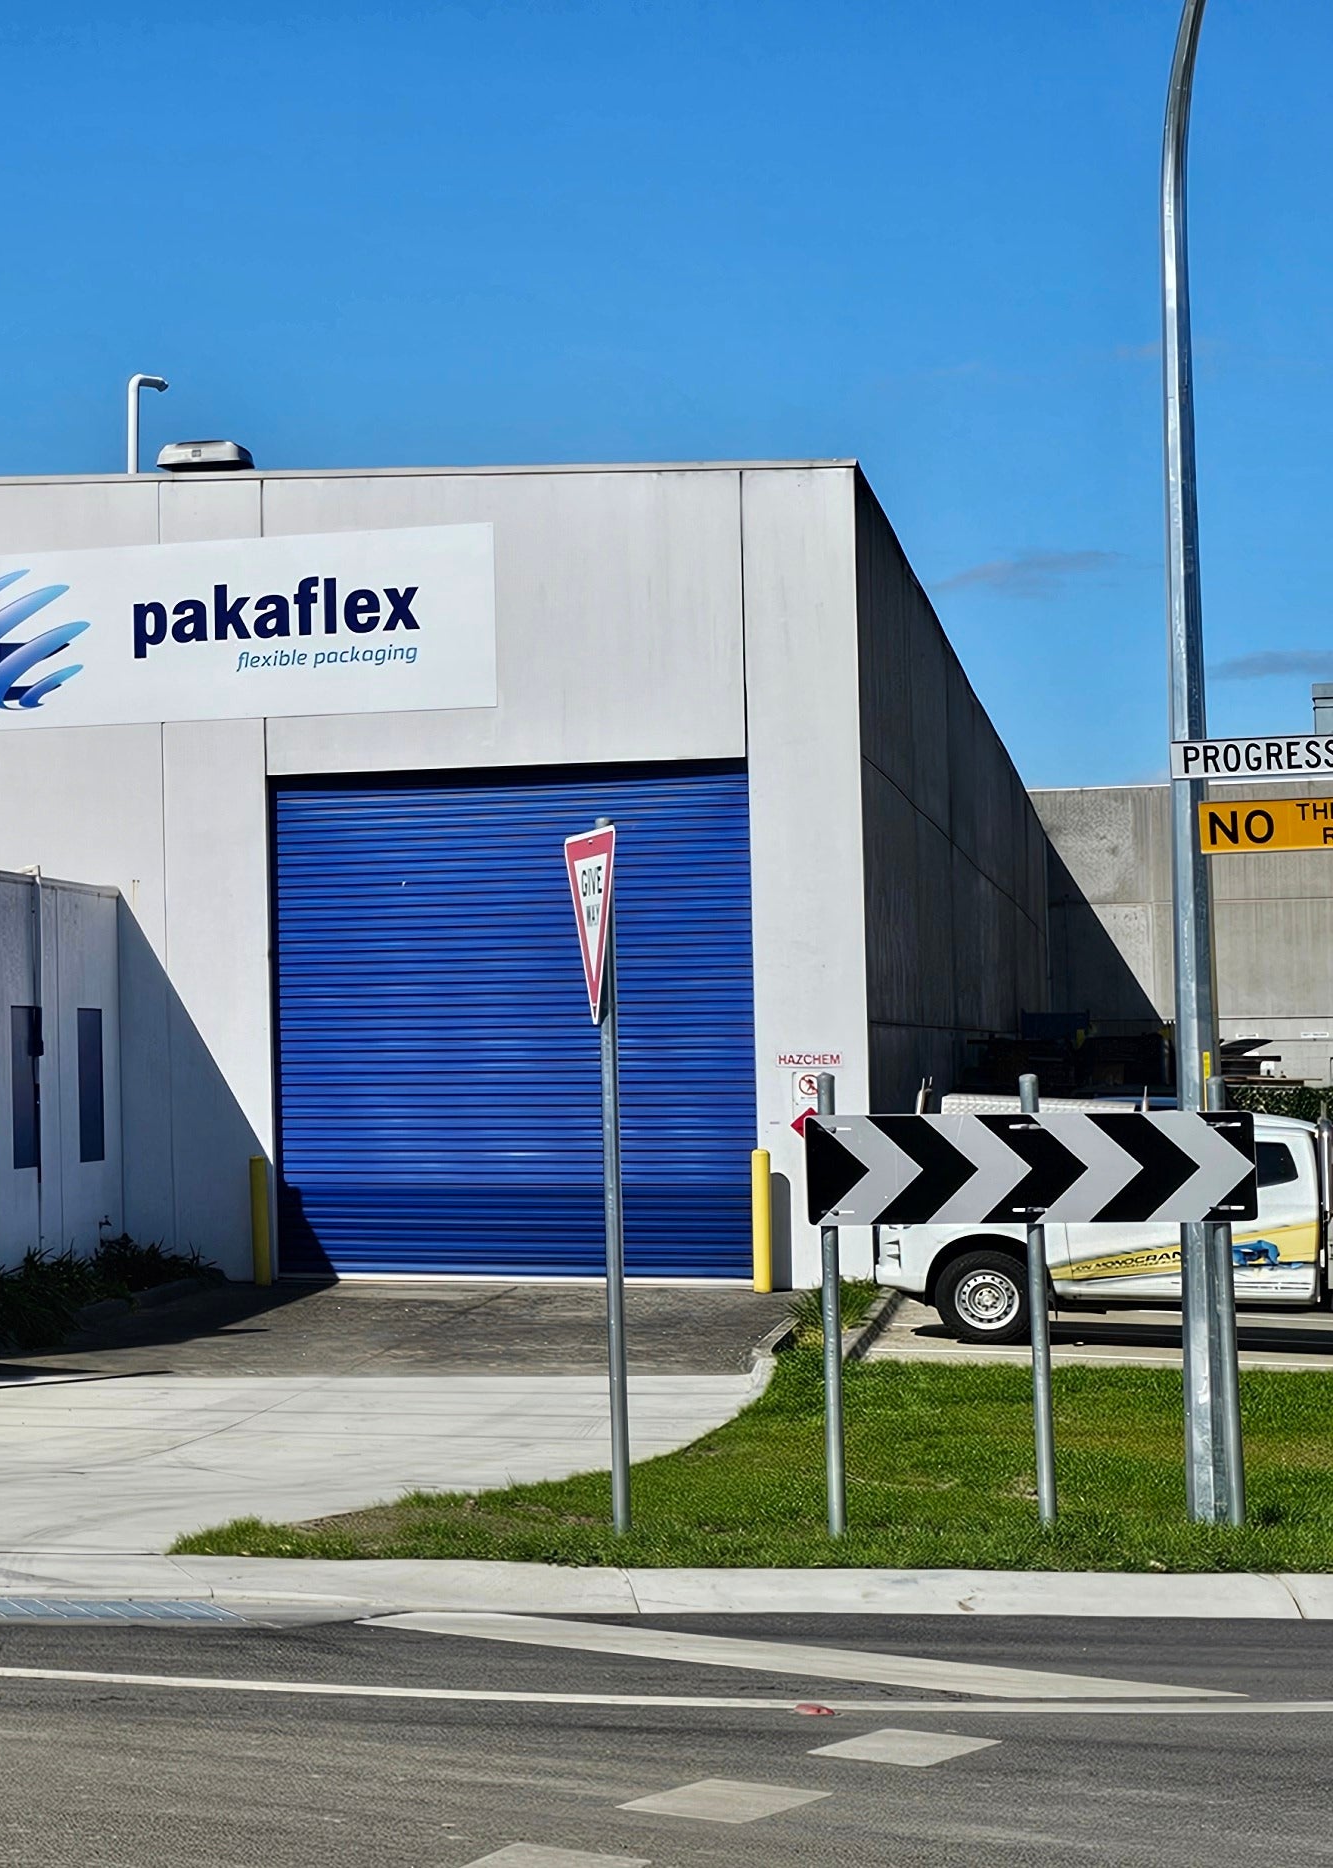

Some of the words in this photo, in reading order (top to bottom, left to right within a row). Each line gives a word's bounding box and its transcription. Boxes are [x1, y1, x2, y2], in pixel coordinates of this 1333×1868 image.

[133, 576, 421, 659] pakaflex
[236, 649, 308, 672] flexible
[313, 644, 418, 668] packaging
[1295, 802, 1333, 821] TH
[1208, 809, 1275, 846] NO
[581, 865, 603, 897] GIVE
[586, 903, 600, 927] WAY
[778, 1054, 841, 1065] HAZCHEM
